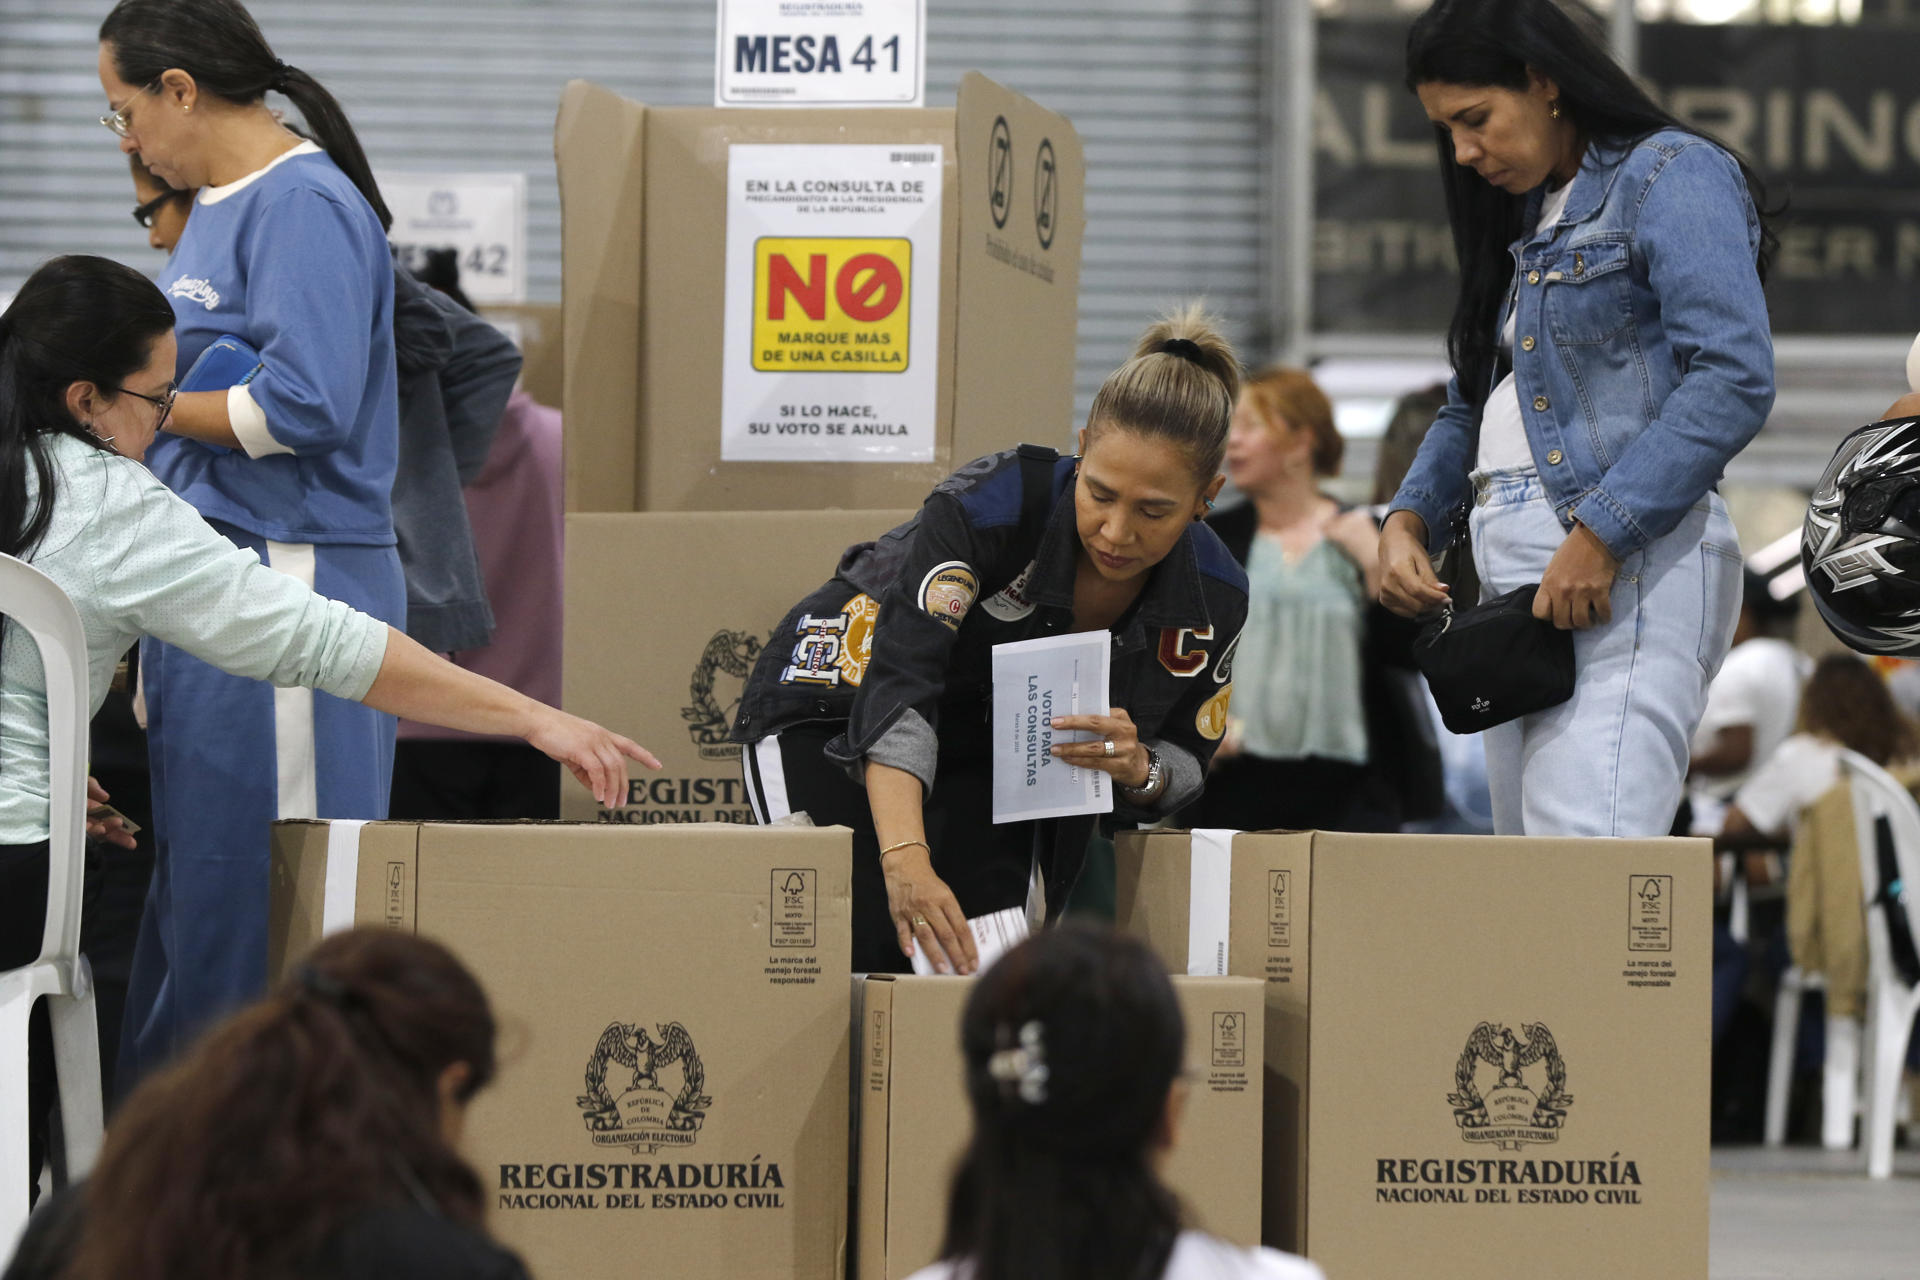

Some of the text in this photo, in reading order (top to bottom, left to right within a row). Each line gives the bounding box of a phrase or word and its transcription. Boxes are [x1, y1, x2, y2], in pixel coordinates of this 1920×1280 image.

[734, 35, 900, 73] MESA 41
[745, 180, 924, 193] EN LA CONSULTA DE
[856, 196, 924, 204] PRESIDENCIA
[796, 205, 809, 213] DE
[464, 244, 508, 275] 42
[767, 253, 904, 322] NO
[777, 331, 891, 344] MARQUE MÁS
[762, 350, 902, 363] DE UNA CASILLA
[779, 405, 877, 419] SI LO HACE,
[748, 422, 908, 436] SU VOTO SE ANULA
[811, 620, 828, 677] CHEVIGNON
[1026, 675, 1038, 787] LAS CONSULTAS
[1041, 690, 1052, 767] VOTO PARA
[598, 810, 705, 824] NACIONAL
[784, 896, 804, 904] FSC
[764, 966, 821, 975] manejo forestal
[769, 977, 815, 985] responsable
[627, 1097, 664, 1108] REPÚBLICA
[626, 1115, 664, 1126] COLOMBIA
[595, 1130, 693, 1144] ORGANIZACIÓN ELECTORAL
[1464, 1127, 1556, 1140] ORGANIZACIÓN ELECTORAL
[498, 1154, 785, 1190] REGISTRADURÍA
[1375, 1151, 1642, 1186] REGISTRADURÍA
[499, 1193, 785, 1210] NACIONAL DEL ESTADO CIVIL
[1376, 1188, 1642, 1205] NACIONAL DEL ESTADO CIVIL
